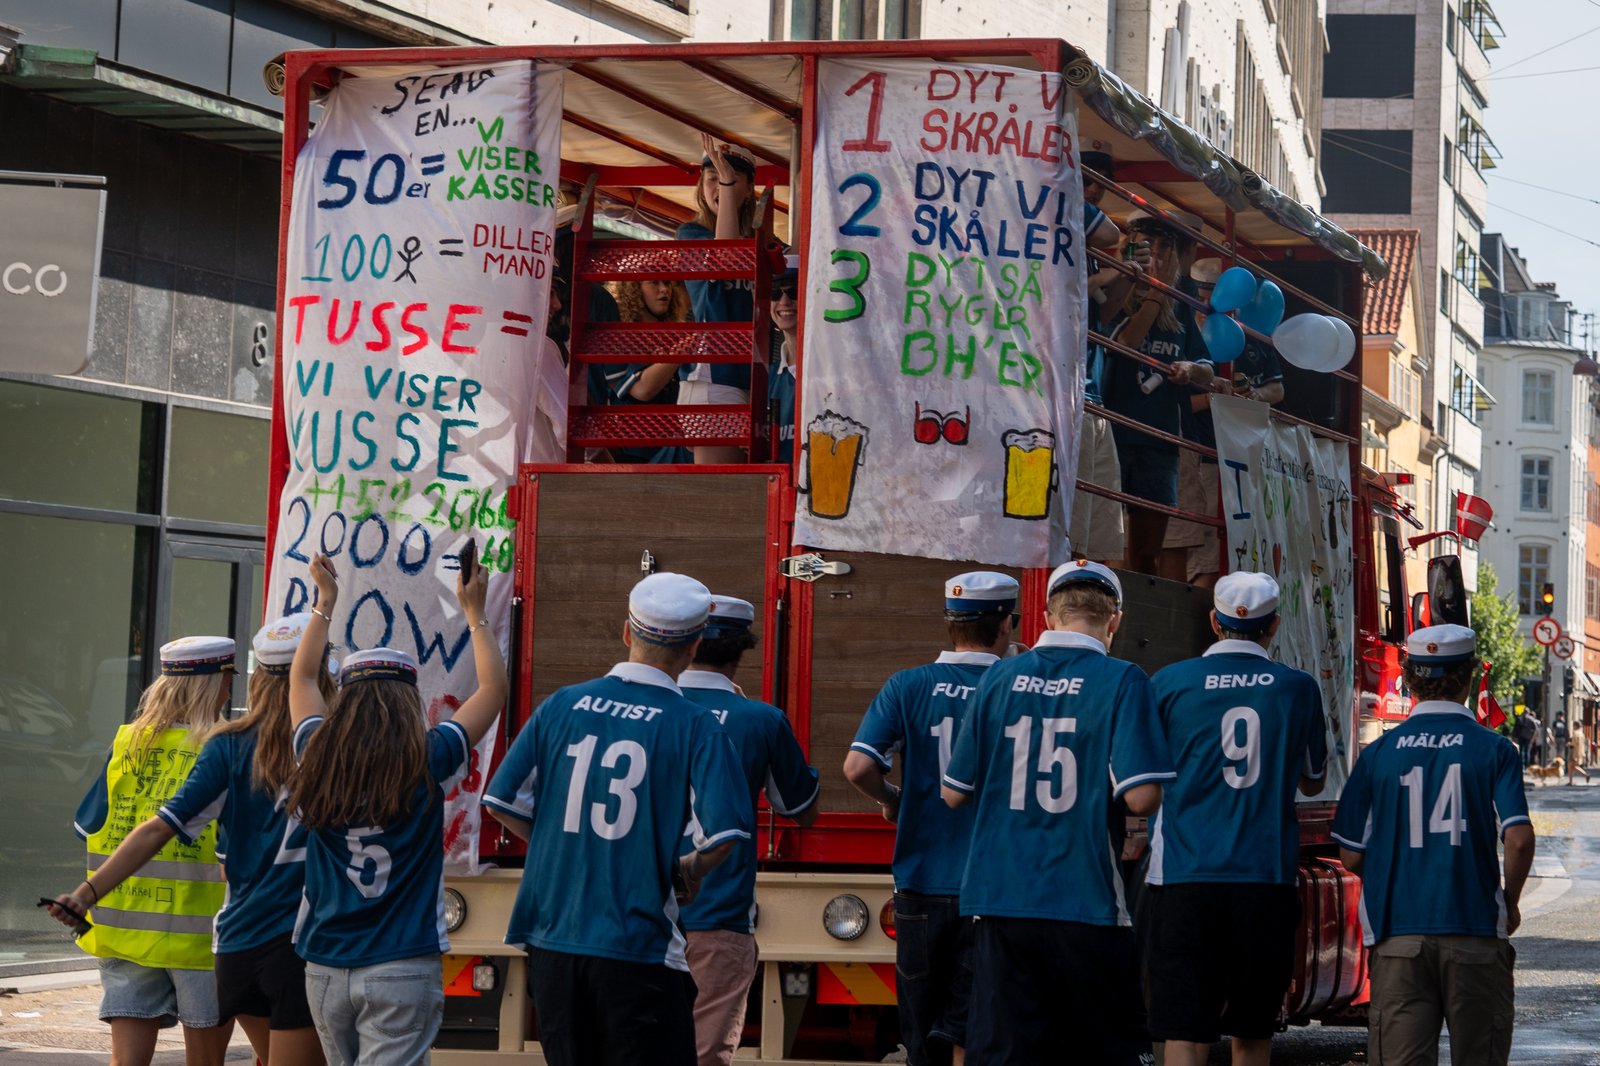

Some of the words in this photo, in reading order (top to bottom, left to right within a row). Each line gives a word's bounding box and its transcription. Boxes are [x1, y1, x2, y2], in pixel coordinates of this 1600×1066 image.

[842, 71, 892, 153] 1
[927, 69, 1015, 104] DYT
[477, 116, 504, 143] VI
[919, 103, 1075, 169] SKRÅLER
[446, 173, 555, 209] KASSER
[457, 146, 543, 176] VISER
[838, 172, 884, 238] 2
[914, 161, 996, 208] DYT
[1016, 179, 1066, 226] VI
[301, 232, 392, 283] 100
[473, 223, 553, 256] DILLER
[911, 203, 1075, 267] SKÅLER
[483, 252, 546, 280] MAND
[823, 248, 871, 323] 3
[904, 251, 986, 288] DYT
[996, 260, 1043, 306] SÅ
[289, 295, 484, 356] TUSSE
[296, 359, 334, 398] VI
[364, 364, 482, 416] VISER
[283, 495, 432, 576] 2000
[573, 694, 663, 722] AUTIST
[1011, 674, 1084, 697] BREDE
[1204, 672, 1275, 691] BENJO
[930, 716, 965, 800] 1
[1004, 715, 1078, 814] 15
[1221, 706, 1261, 790] 9
[1396, 733, 1464, 750] MÄLKA
[563, 734, 647, 840] 13
[1399, 763, 1467, 848] 14
[345, 825, 393, 899] 5
